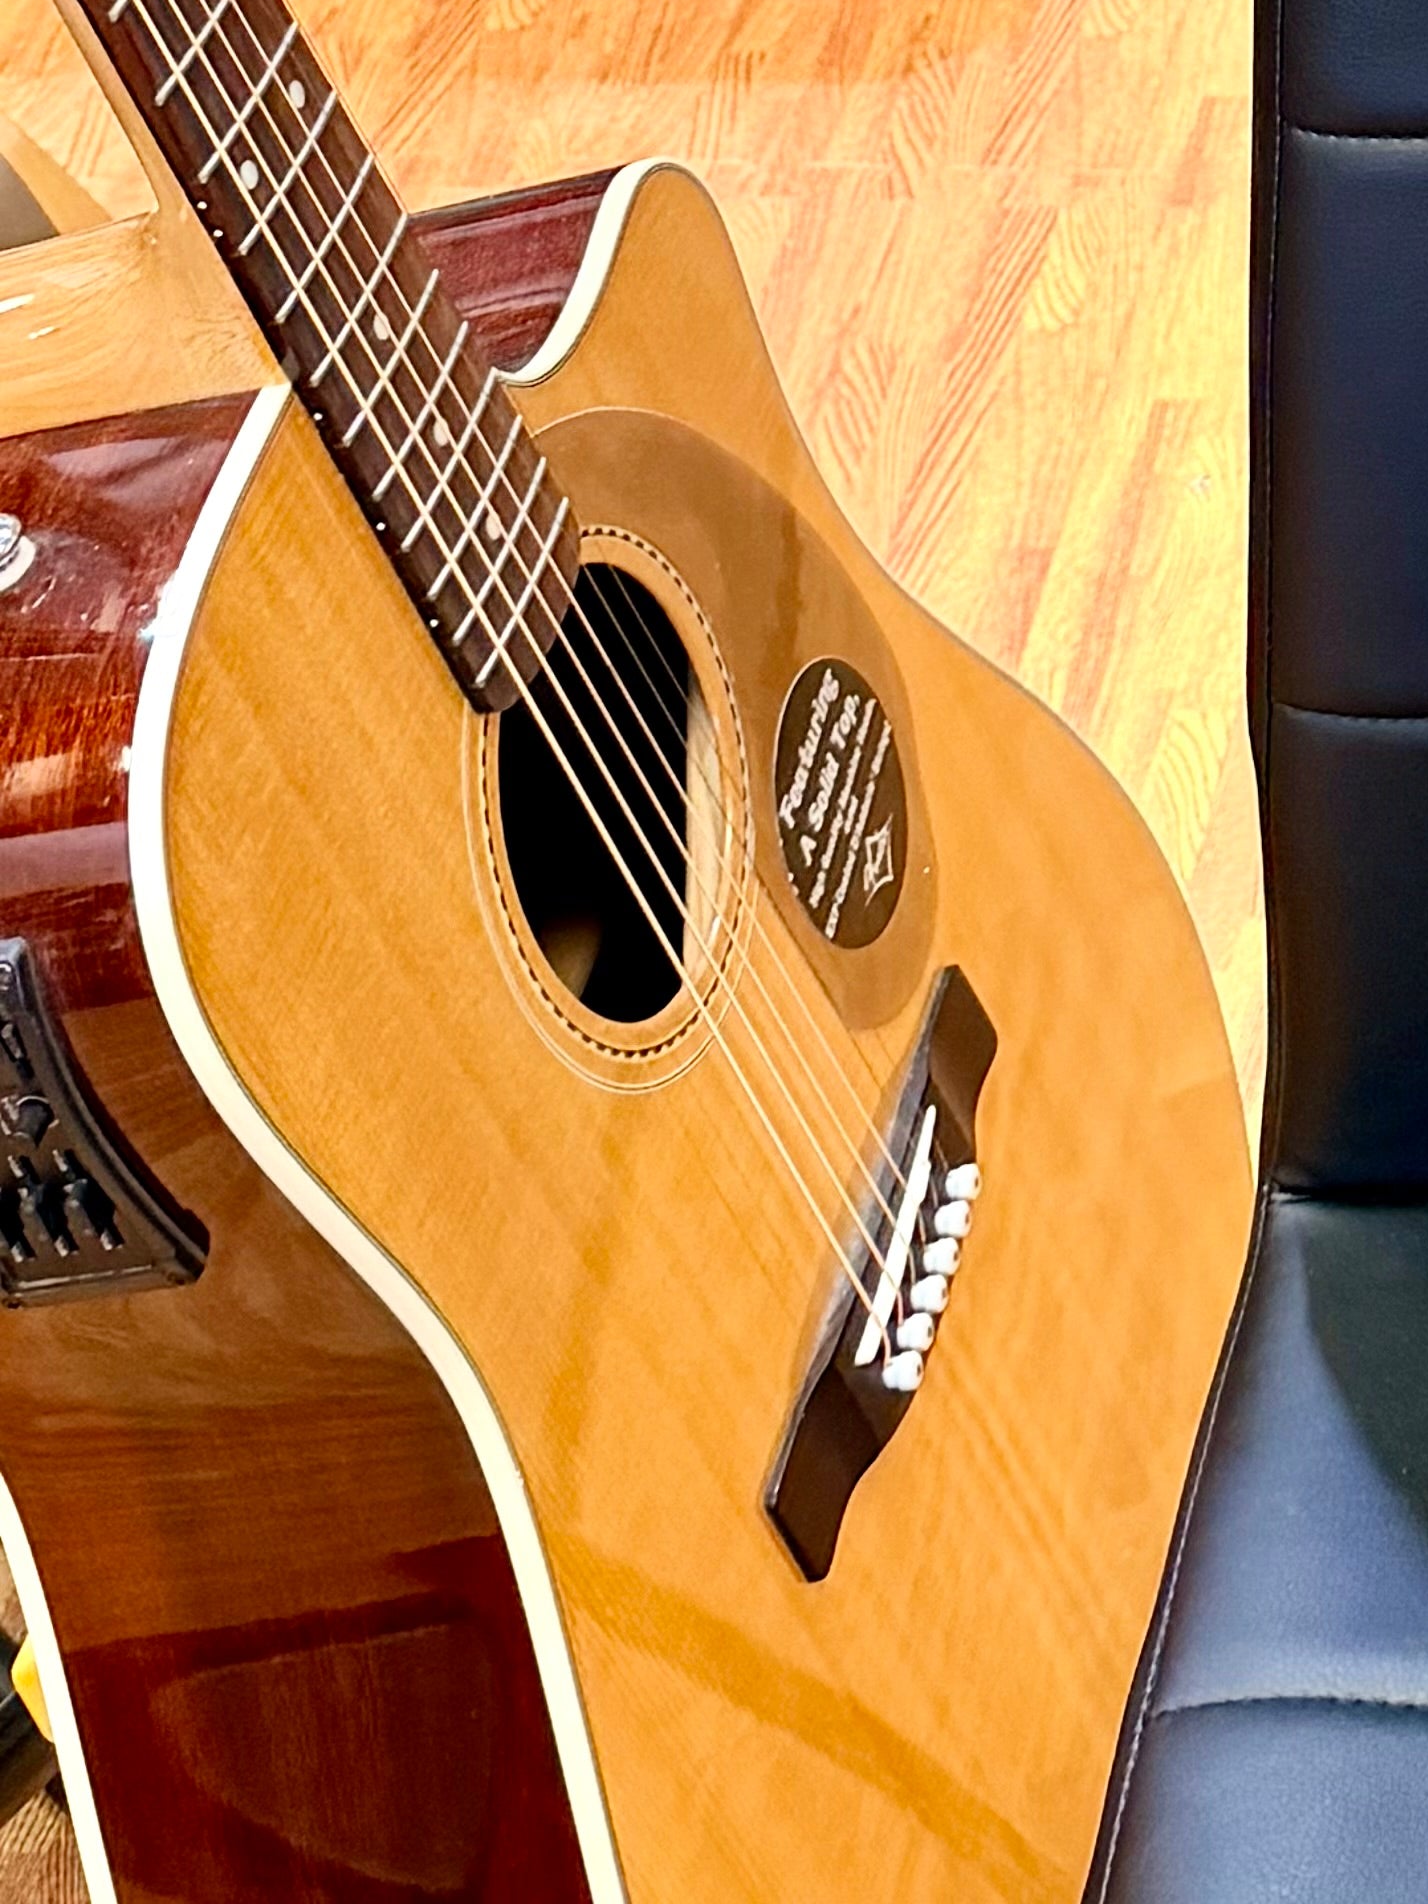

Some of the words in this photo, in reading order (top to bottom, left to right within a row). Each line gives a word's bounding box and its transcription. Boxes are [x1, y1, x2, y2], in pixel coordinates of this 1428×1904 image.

[779, 667, 840, 830] Featuring
[808, 751, 840, 833] Solid
[800, 835, 817, 868] A
